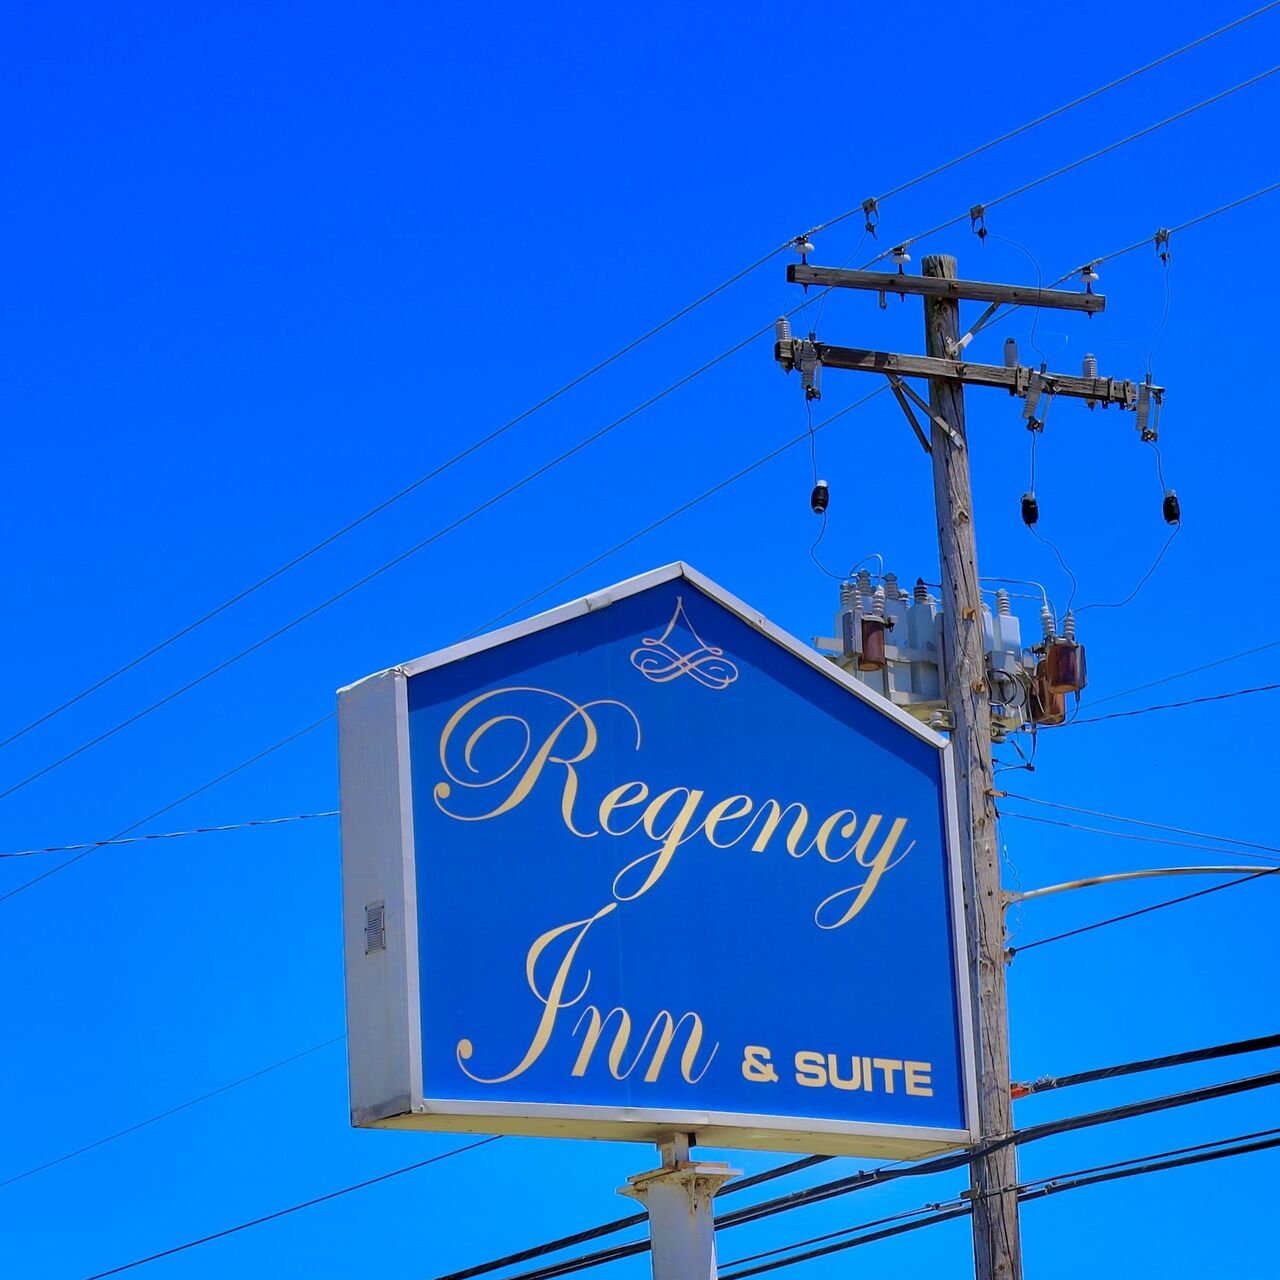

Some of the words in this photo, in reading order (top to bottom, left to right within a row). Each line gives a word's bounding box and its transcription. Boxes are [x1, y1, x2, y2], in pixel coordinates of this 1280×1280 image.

[433, 686, 916, 930] Regency
[455, 902, 719, 1084] Inn
[741, 1045, 779, 1083] &
[794, 1051, 933, 1098] SUITE
